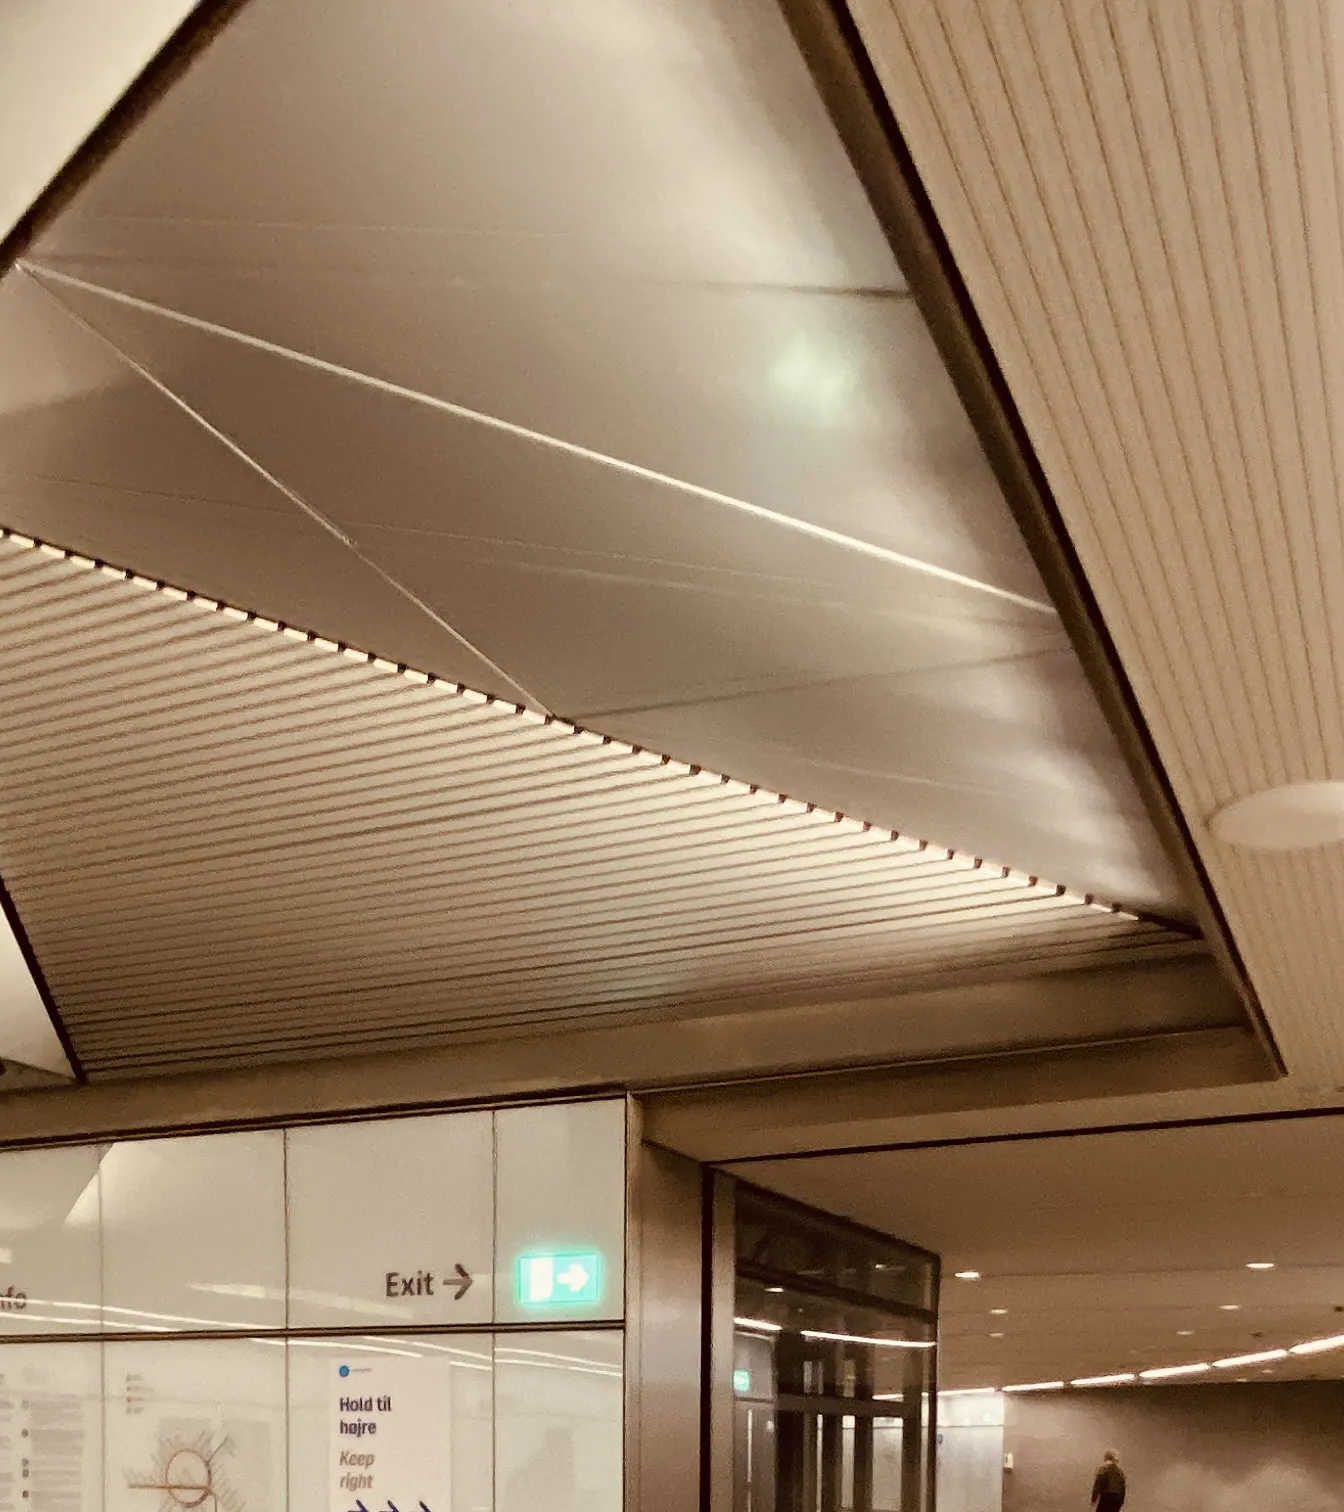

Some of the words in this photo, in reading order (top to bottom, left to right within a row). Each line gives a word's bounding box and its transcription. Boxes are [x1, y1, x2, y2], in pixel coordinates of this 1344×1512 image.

[386, 1270, 434, 1297] Exit
[339, 1396, 373, 1412] Hold
[377, 1395, 392, 1412] til
[339, 1418, 377, 1438] højre
[339, 1450, 375, 1469] Keep
[339, 1471, 374, 1492] right
